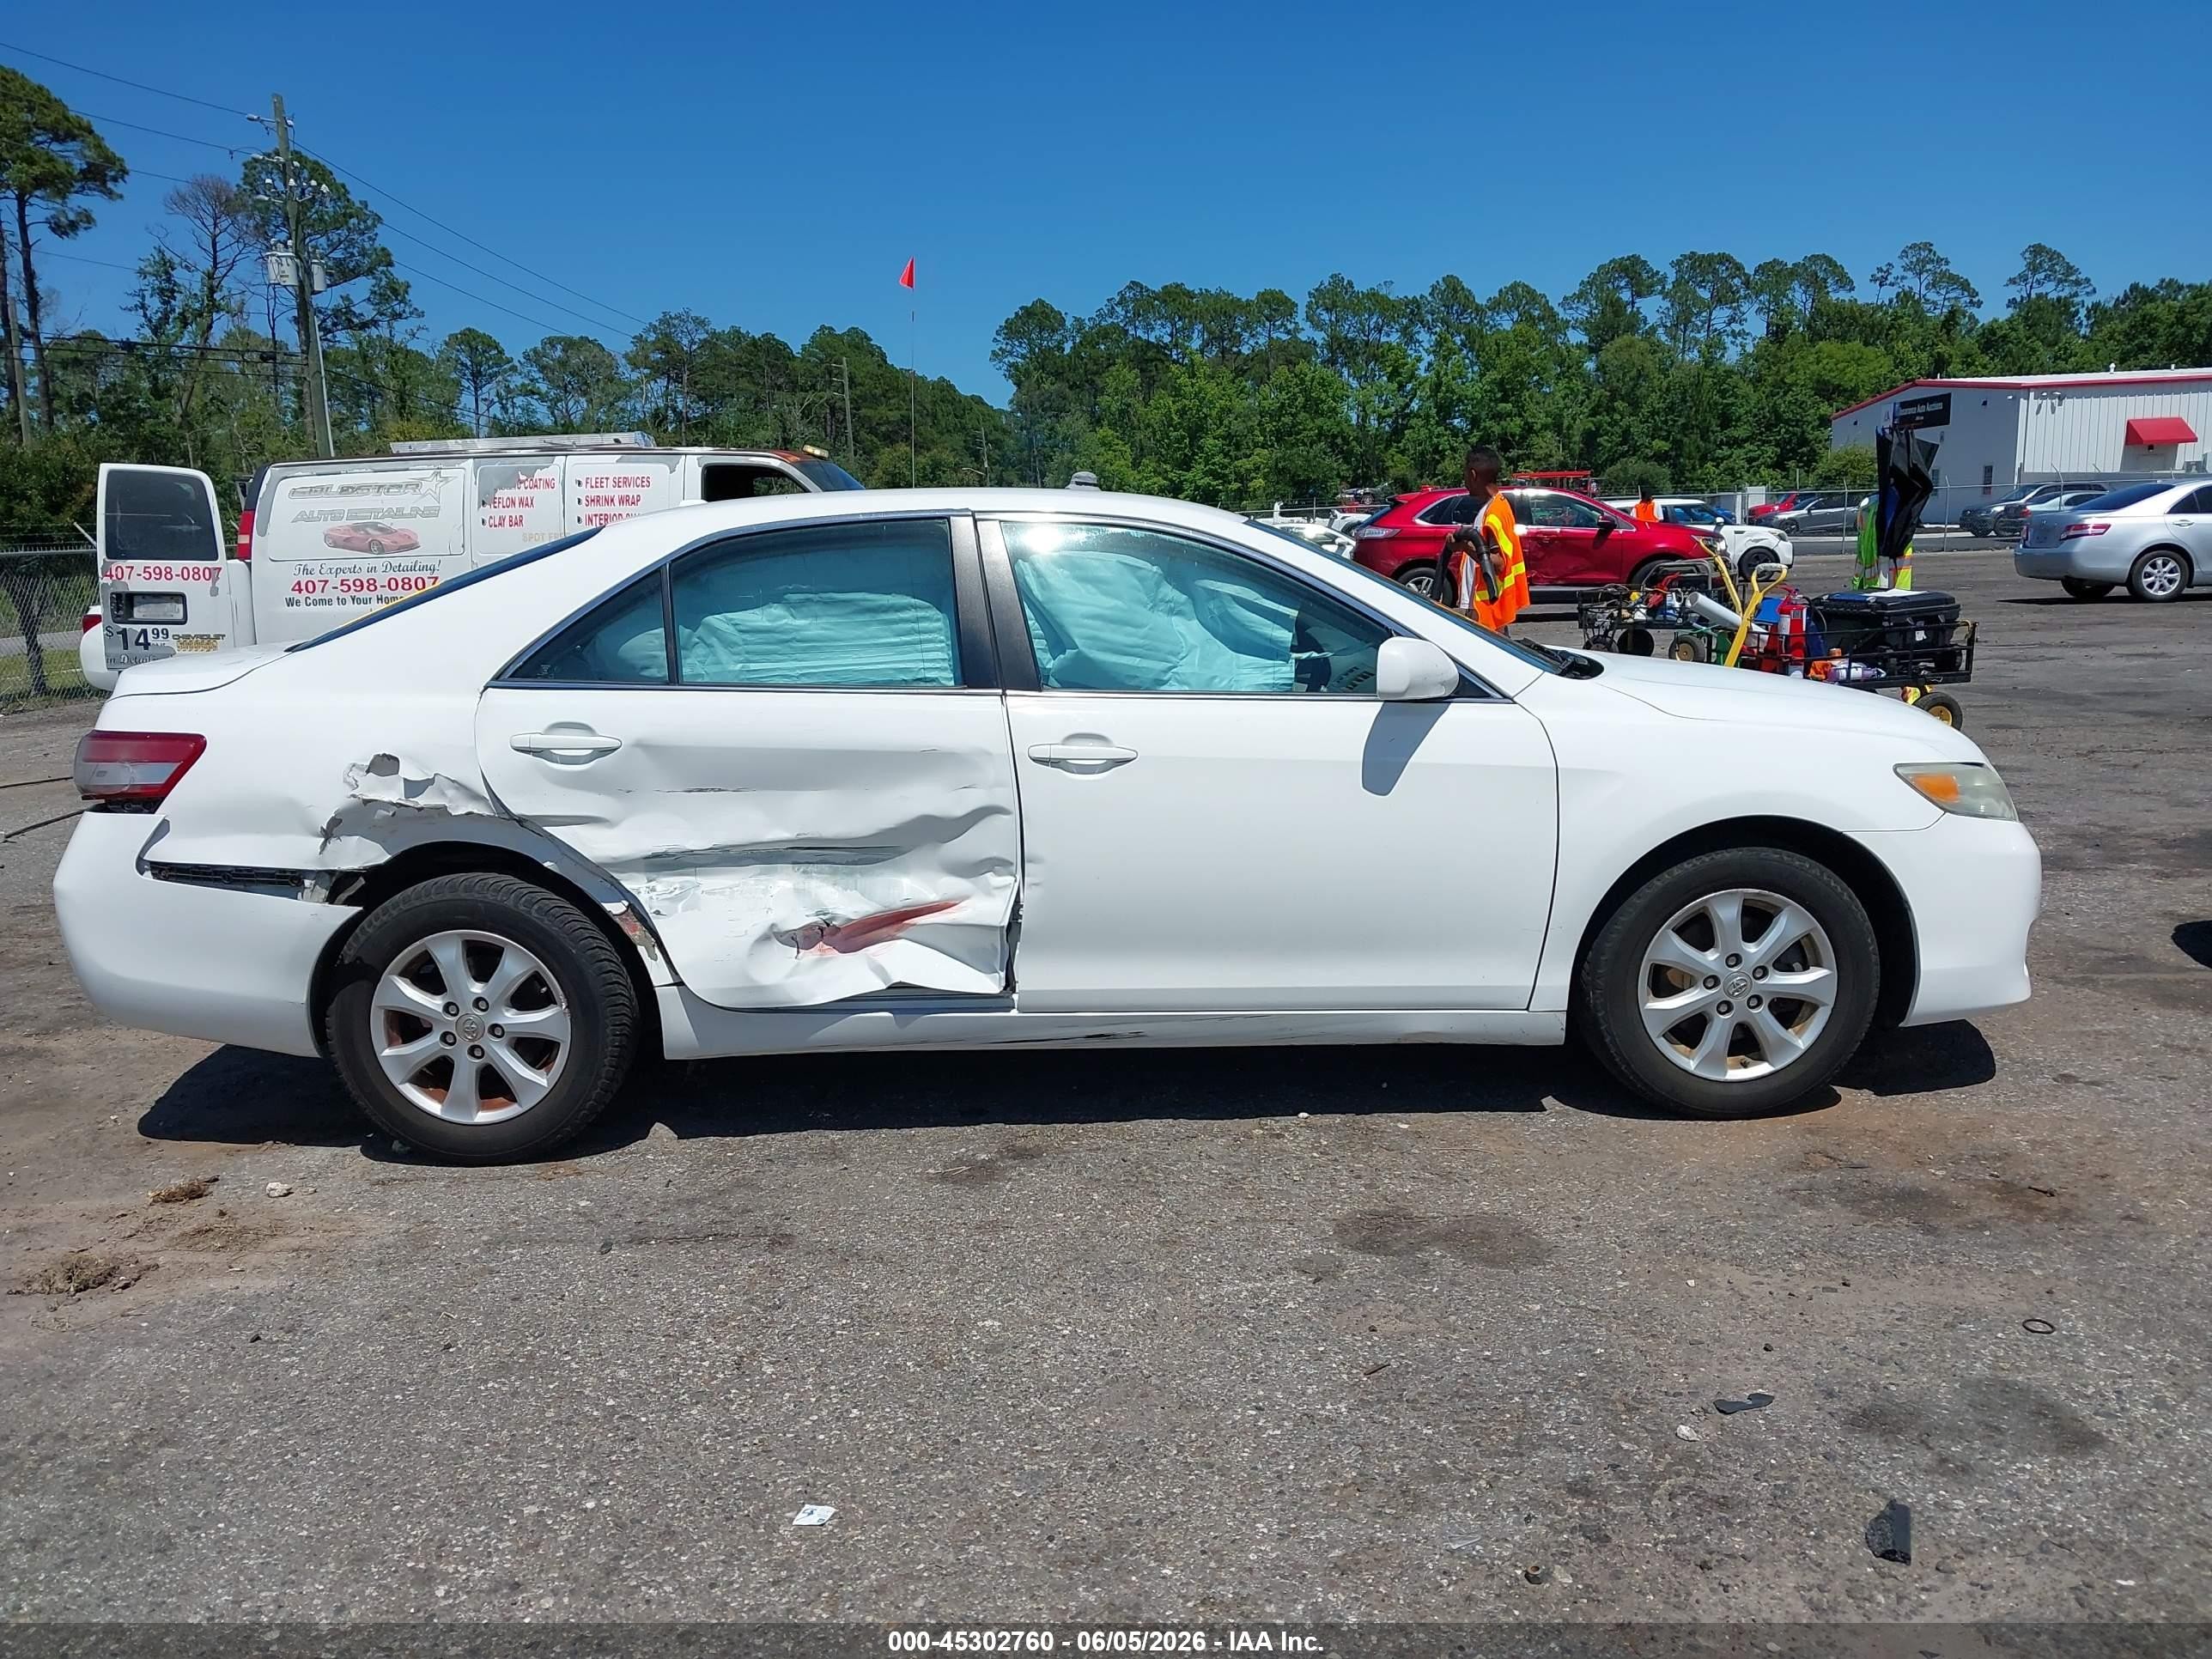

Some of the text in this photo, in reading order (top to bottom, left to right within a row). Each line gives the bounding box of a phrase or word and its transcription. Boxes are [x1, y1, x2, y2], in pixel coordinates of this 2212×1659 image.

[524, 477, 556, 490] COATING
[585, 476, 651, 489] FLEET SERVICES
[518, 496, 535, 508] WAX
[585, 494, 641, 507] SHRINK WRAP
[290, 508, 345, 524] AUTO
[488, 514, 524, 528] CLAY BAR
[105, 565, 222, 581] 407-598-0807
[293, 559, 442, 579] The Experts in Detailing!
[291, 576, 441, 595] 407-598-0807
[285, 597, 301, 608] We
[304, 596, 334, 607] Come
[337, 596, 347, 606] to
[349, 595, 374, 606] Your
